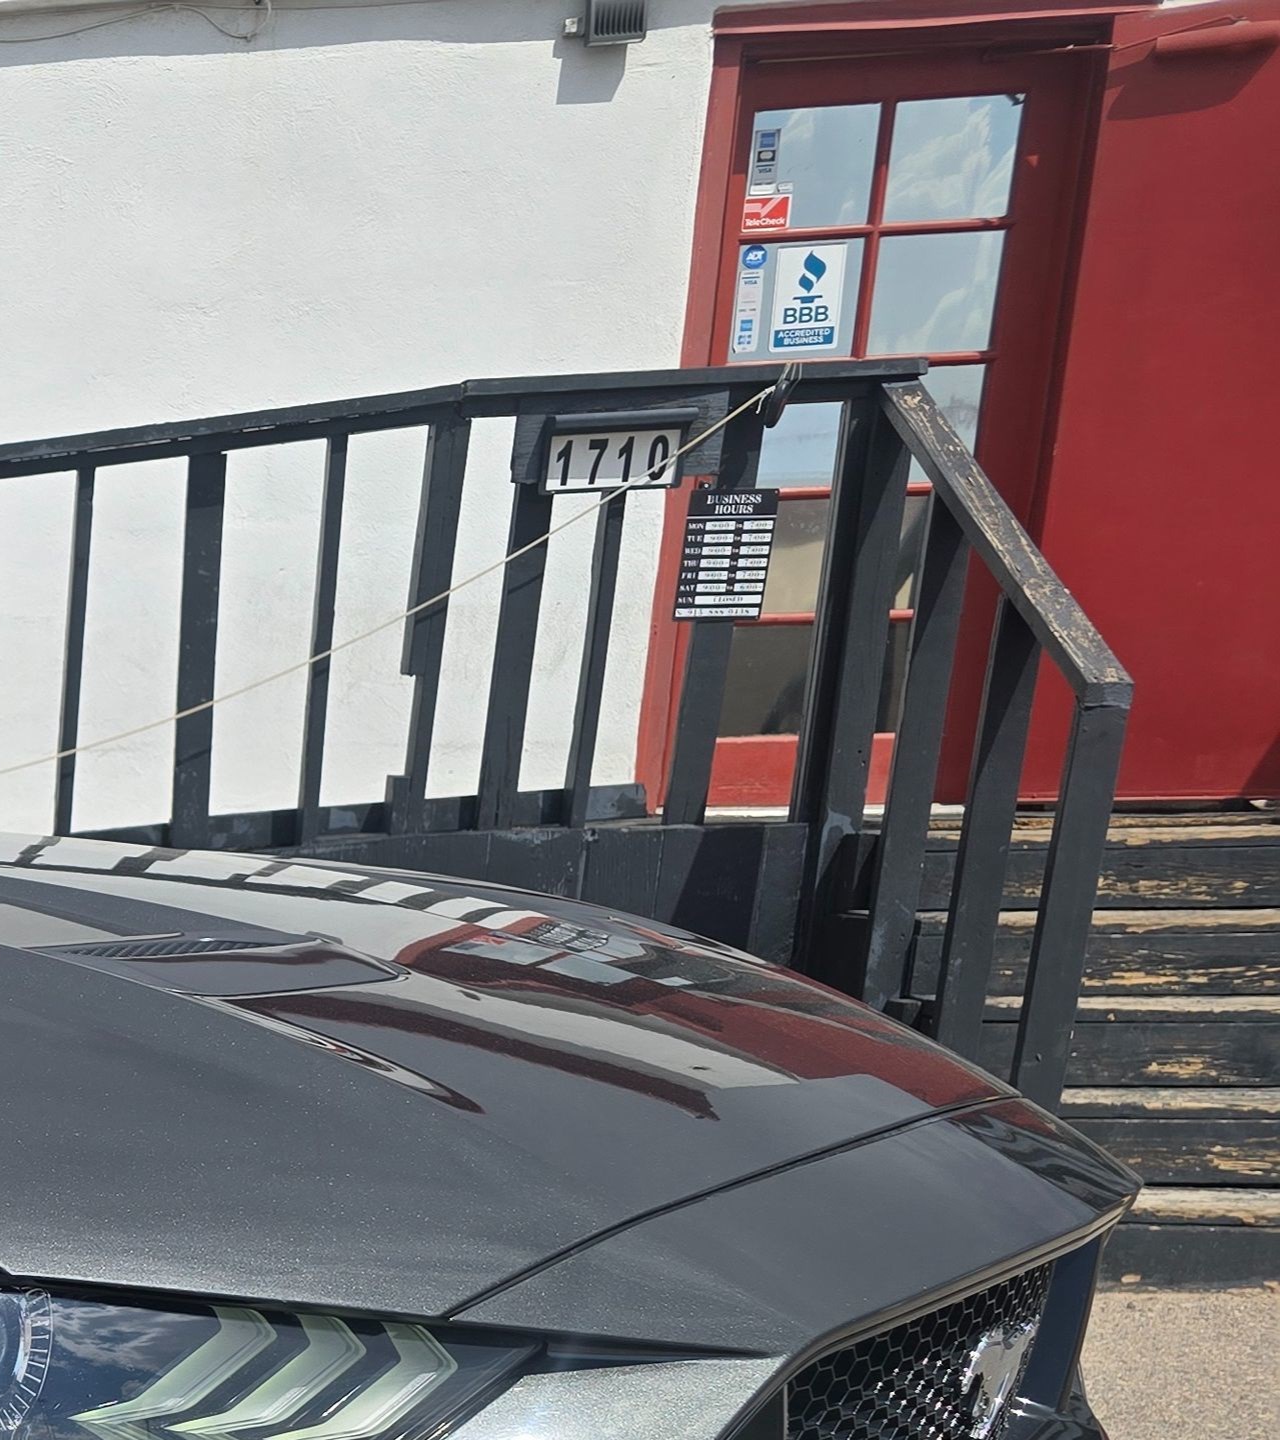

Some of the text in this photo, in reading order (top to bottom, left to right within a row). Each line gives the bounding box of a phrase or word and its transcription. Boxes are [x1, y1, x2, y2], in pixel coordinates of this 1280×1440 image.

[744, 216, 786, 227] TeleCheck
[745, 250, 766, 261] ADT
[782, 305, 830, 325] BBB
[777, 328, 831, 339] ACCREDITED
[783, 335, 825, 346] BUSINESS
[556, 434, 670, 487] 1710
[706, 493, 763, 505] BUSINESS
[714, 504, 755, 515] HOURS
